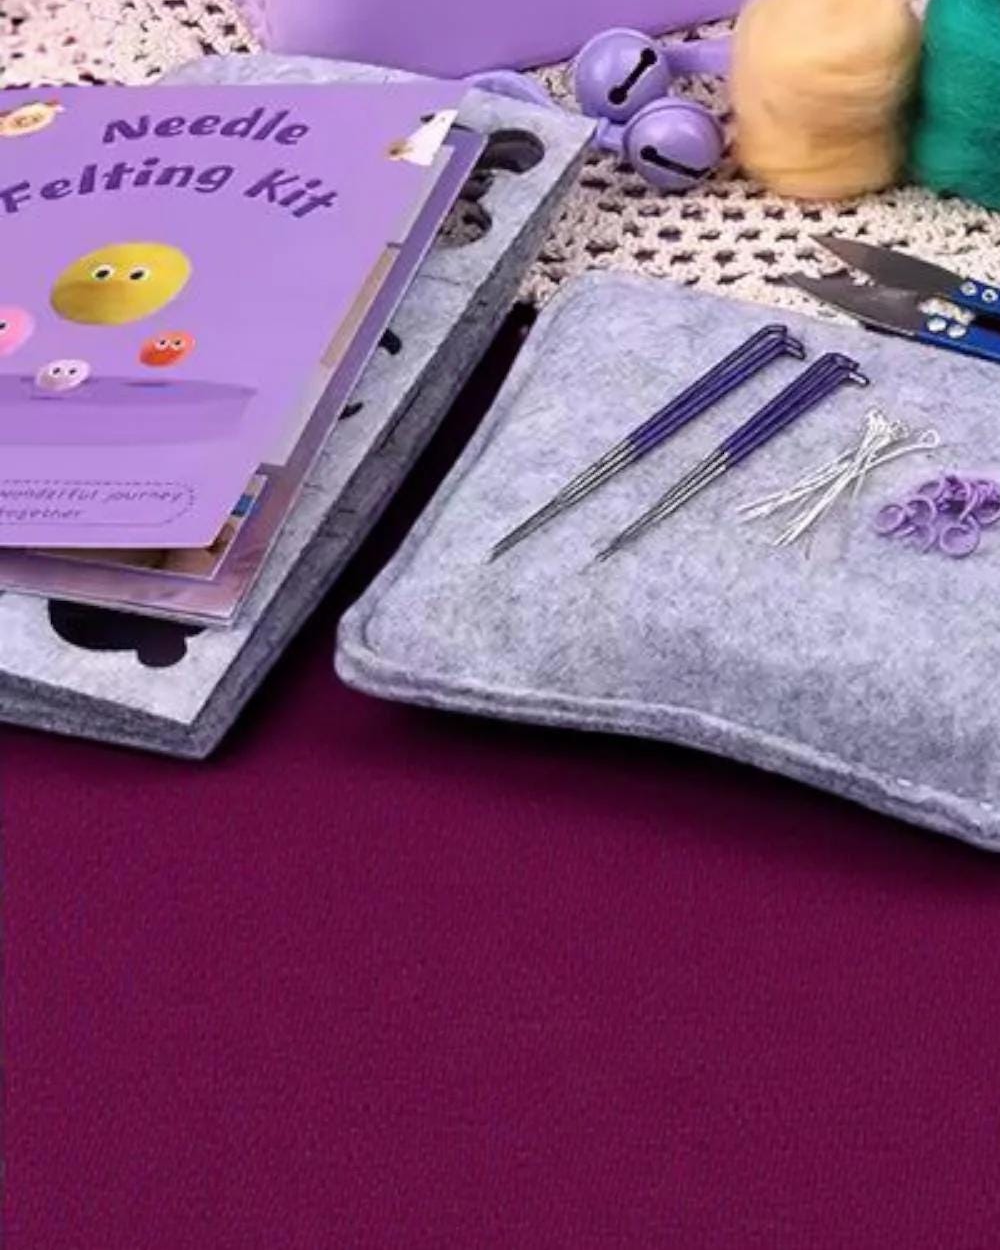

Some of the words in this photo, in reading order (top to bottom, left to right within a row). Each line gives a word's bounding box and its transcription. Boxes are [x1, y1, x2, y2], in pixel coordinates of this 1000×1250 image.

[102, 107, 310, 146] Needle
[0, 157, 235, 214] Felting
[243, 168, 339, 219] Kit
